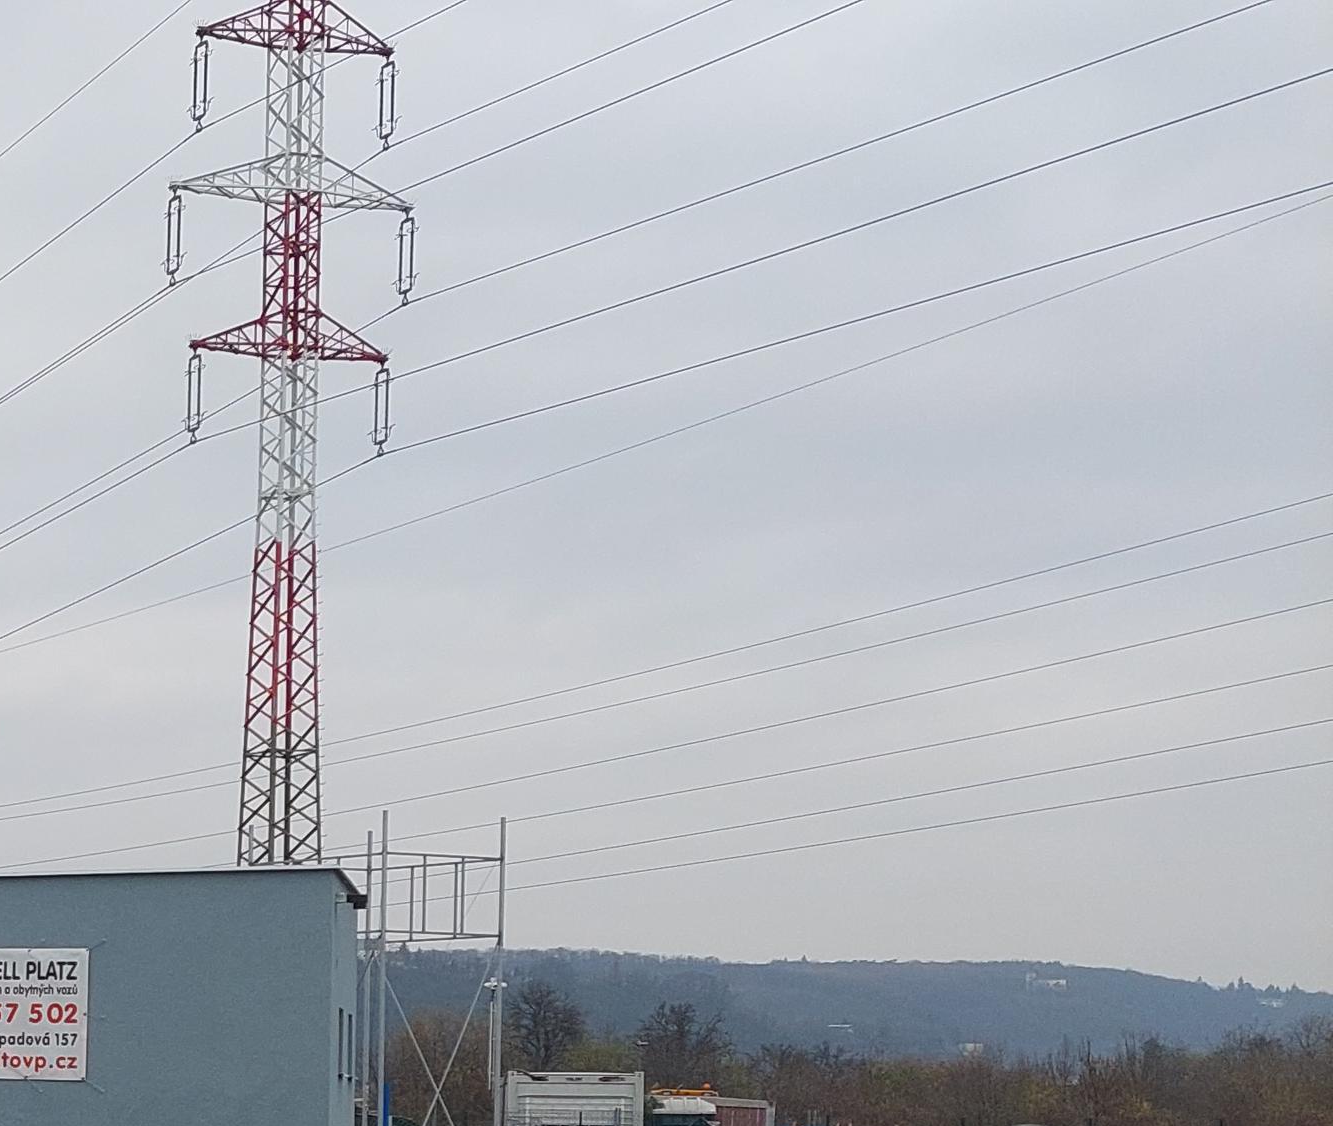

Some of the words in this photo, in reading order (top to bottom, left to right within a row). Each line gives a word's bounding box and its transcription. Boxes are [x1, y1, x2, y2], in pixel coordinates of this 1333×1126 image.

[25, 961, 78, 980] PLATZ
[13, 983, 54, 997] obytných
[28, 1003, 78, 1024] 502
[55, 1033, 78, 1047] 157
